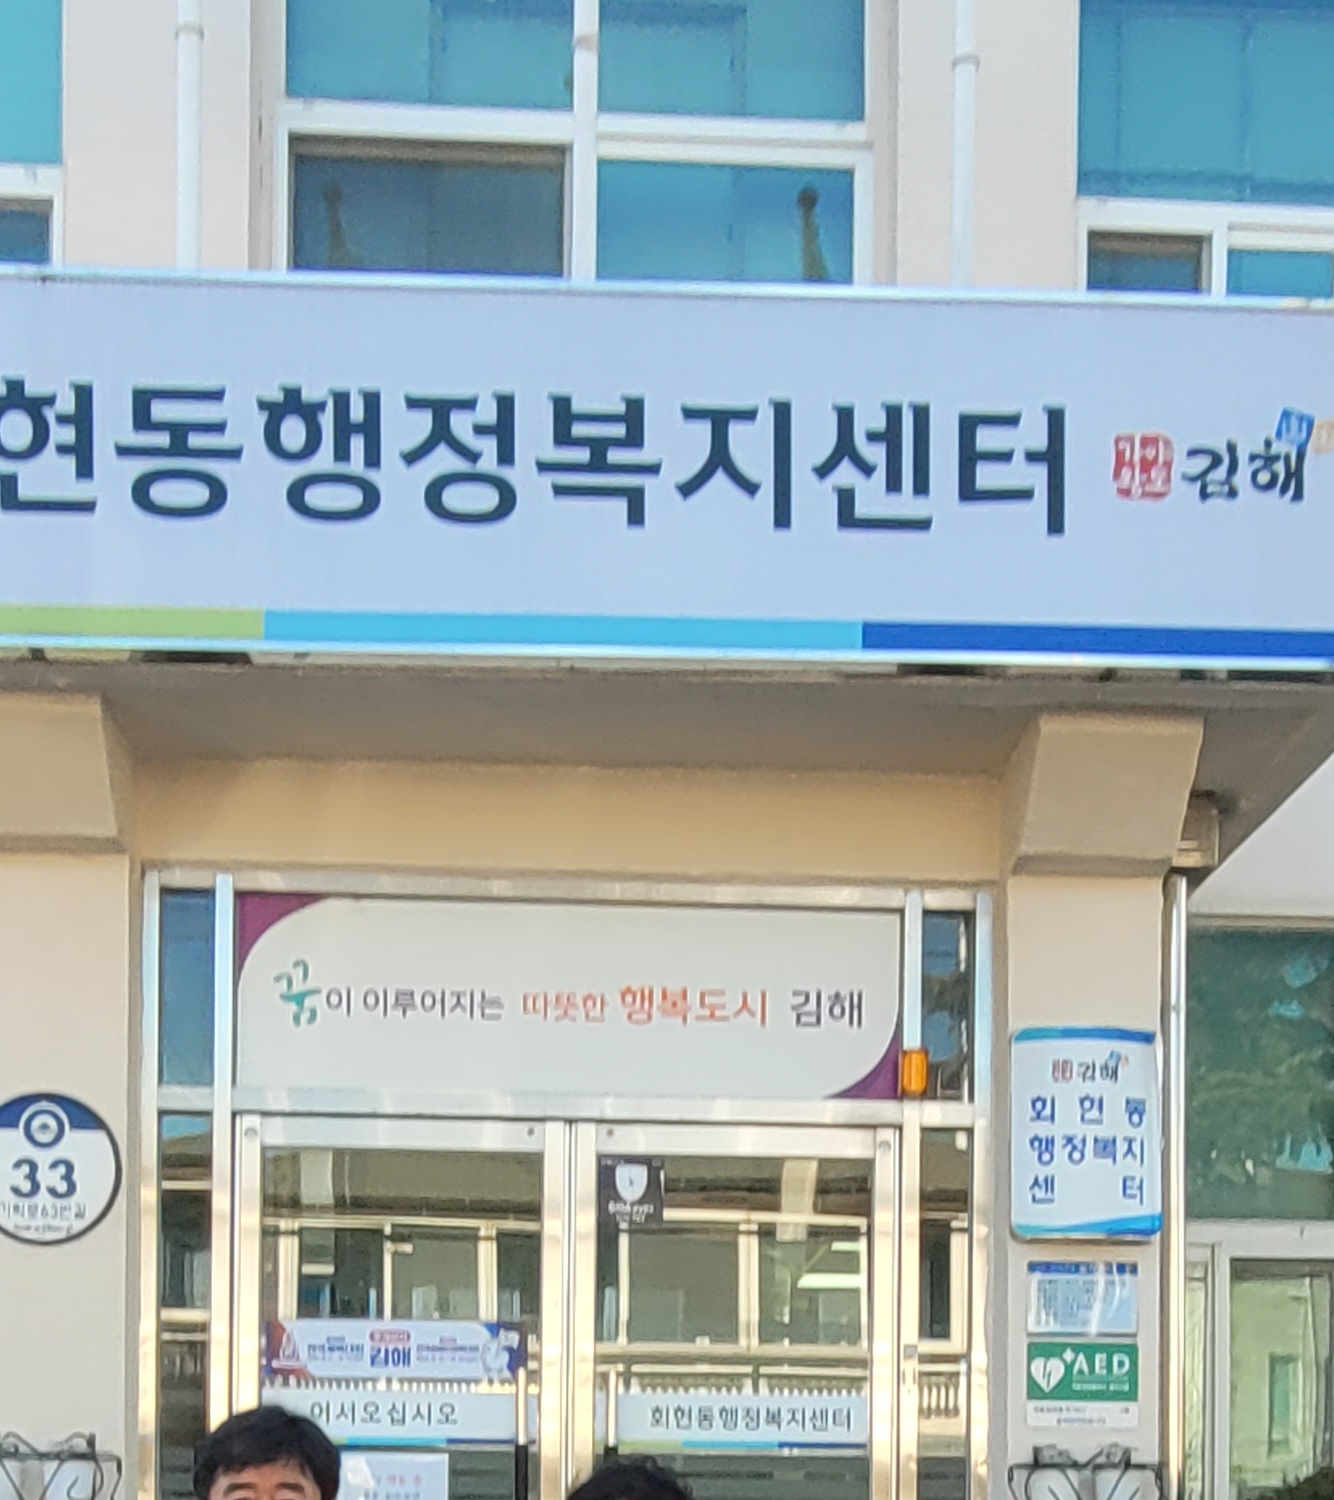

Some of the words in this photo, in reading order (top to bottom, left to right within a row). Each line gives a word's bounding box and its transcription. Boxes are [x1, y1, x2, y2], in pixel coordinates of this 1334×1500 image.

[1181, 434, 1305, 503] 김해
[361, 986, 505, 1022] 이루어지는
[520, 990, 608, 1025] 따뜻한
[618, 984, 769, 1028] 행복도시
[791, 988, 865, 1029] 김해
[1028, 1133, 1145, 1169] 행정복지
[9, 1157, 78, 1199] 33
[1072, 1351, 1131, 1377] AED
[310, 1401, 460, 1430] 어서오십시오
[649, 1403, 853, 1433] 회현동행정복지센터
